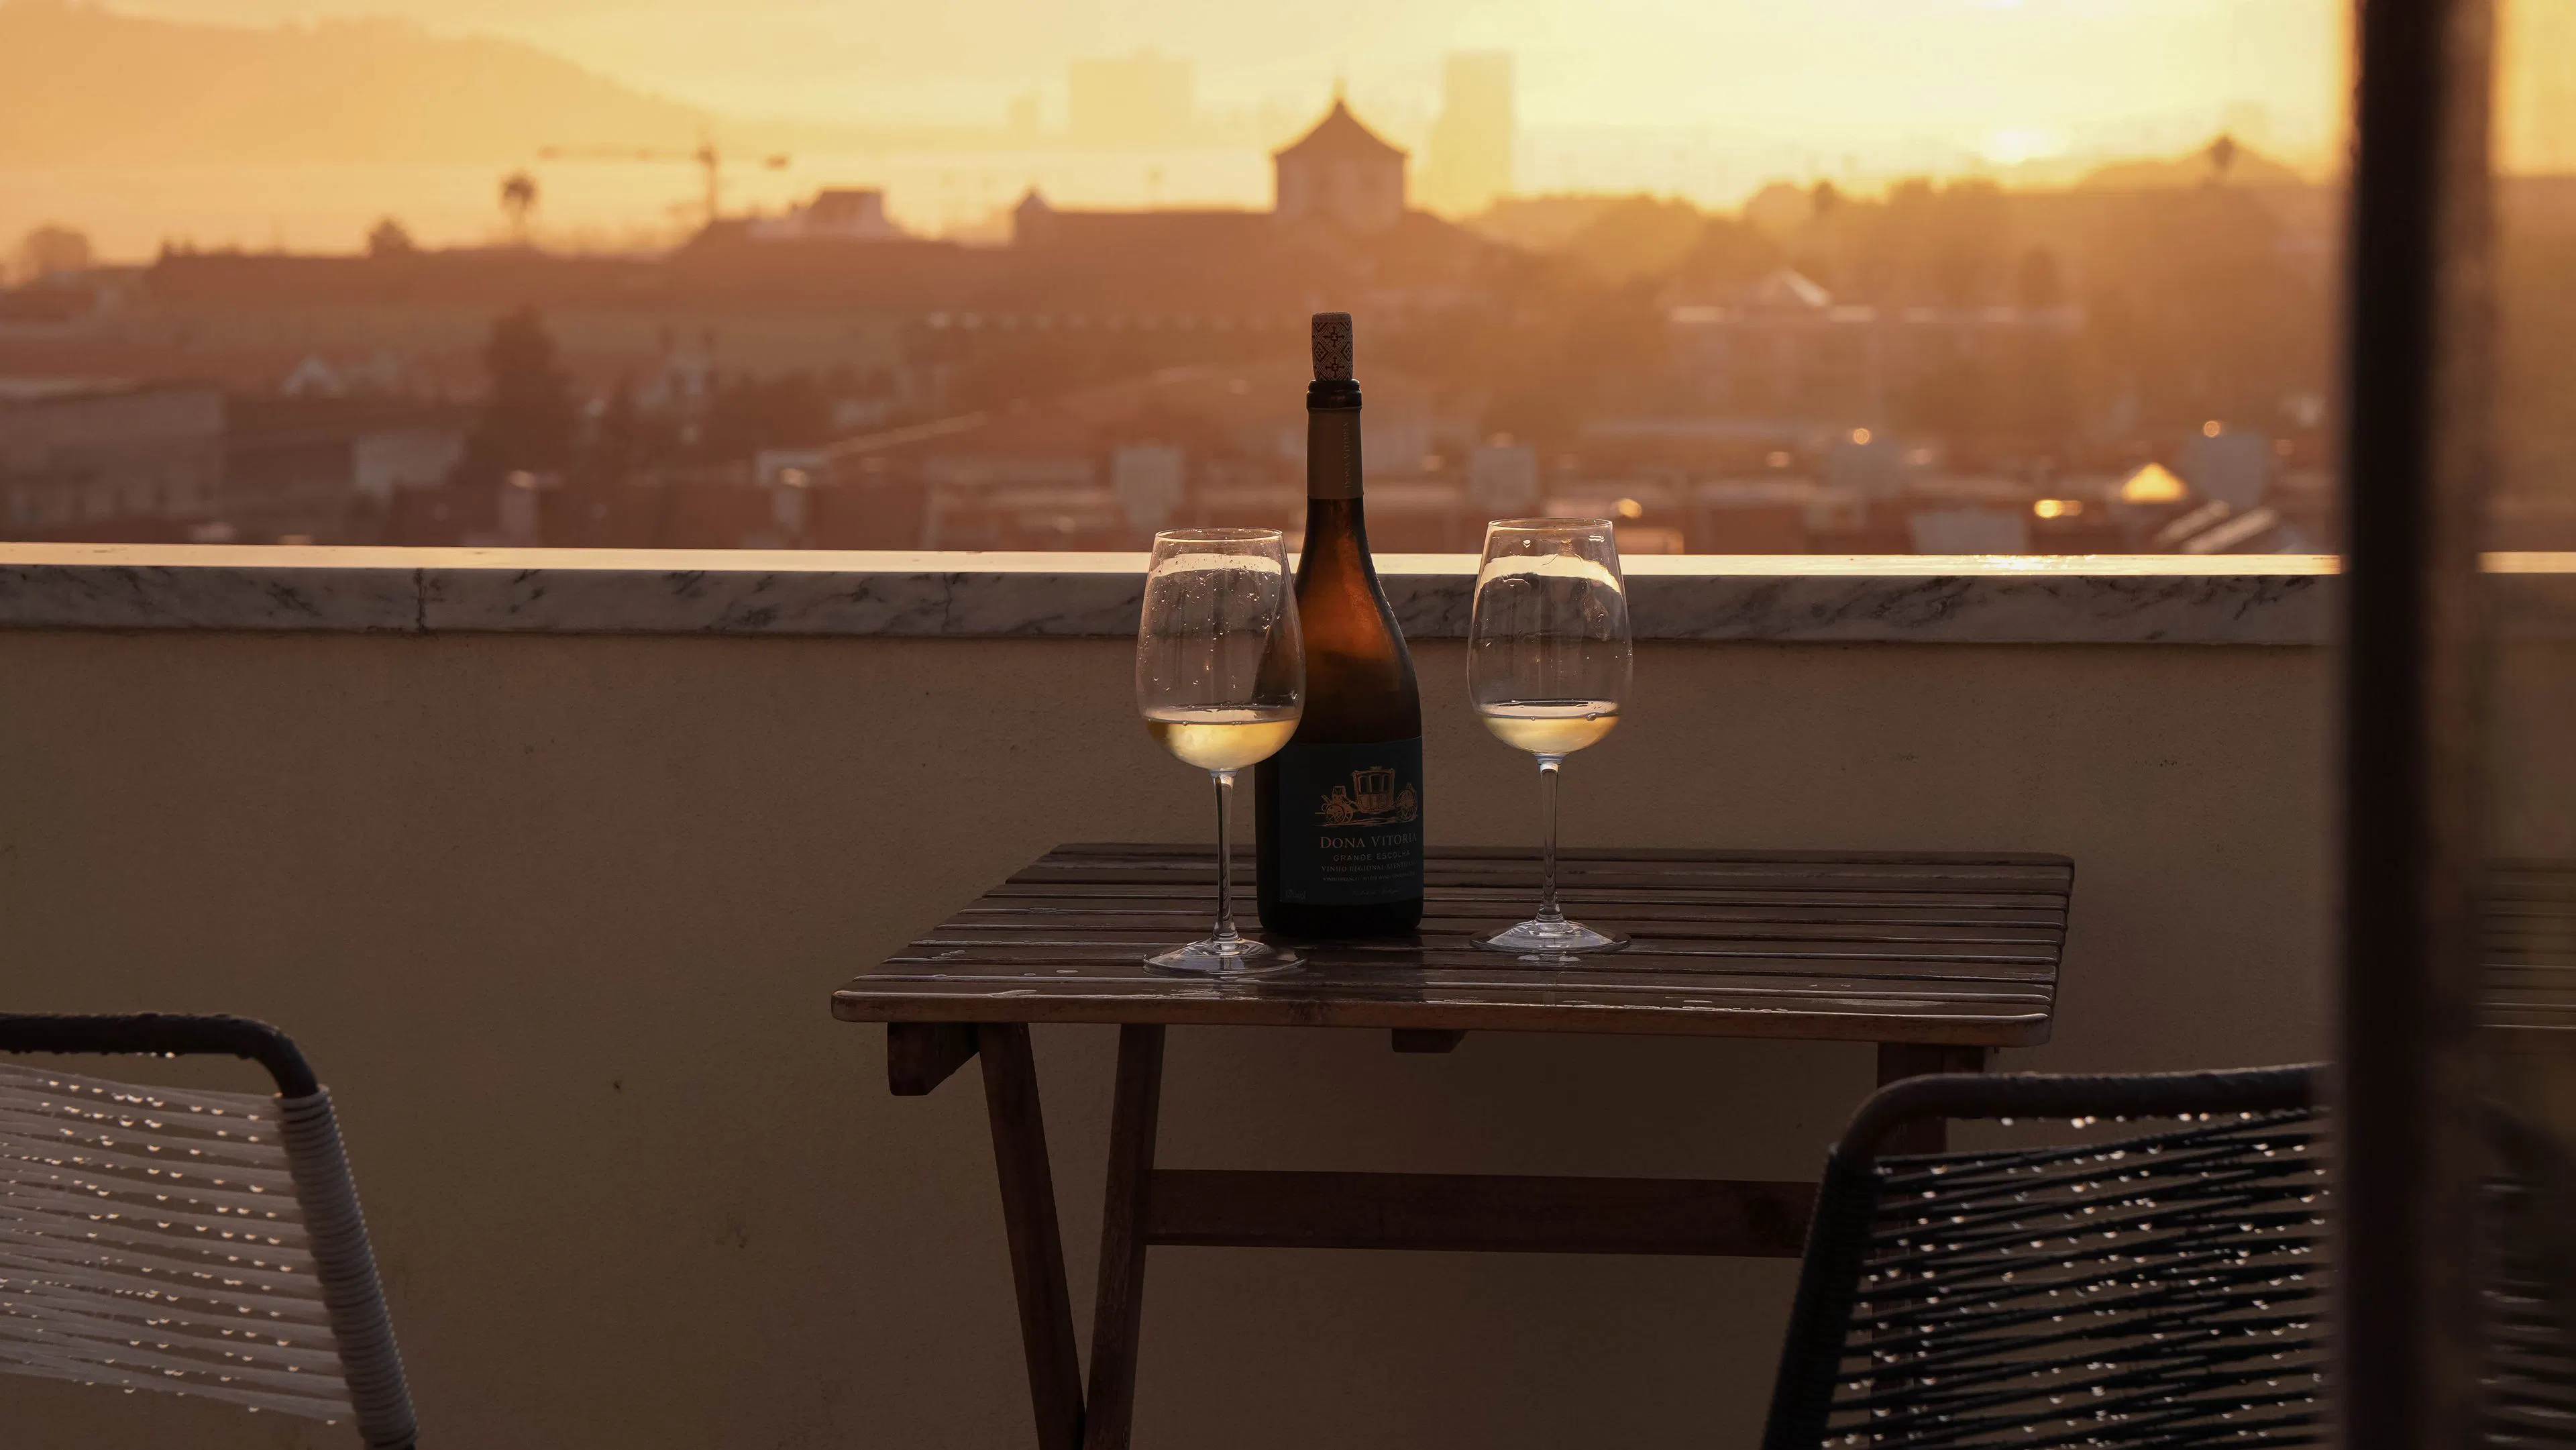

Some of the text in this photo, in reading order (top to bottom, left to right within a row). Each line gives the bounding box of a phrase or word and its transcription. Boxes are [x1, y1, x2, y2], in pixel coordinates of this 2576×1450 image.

[1344, 462, 1352, 488] DONA
[1320, 832, 1417, 849] DONA VITORIA
[1333, 849, 1411, 862] GRANDE ESCOLHA
[1350, 865, 1385, 873] REGIONAL
